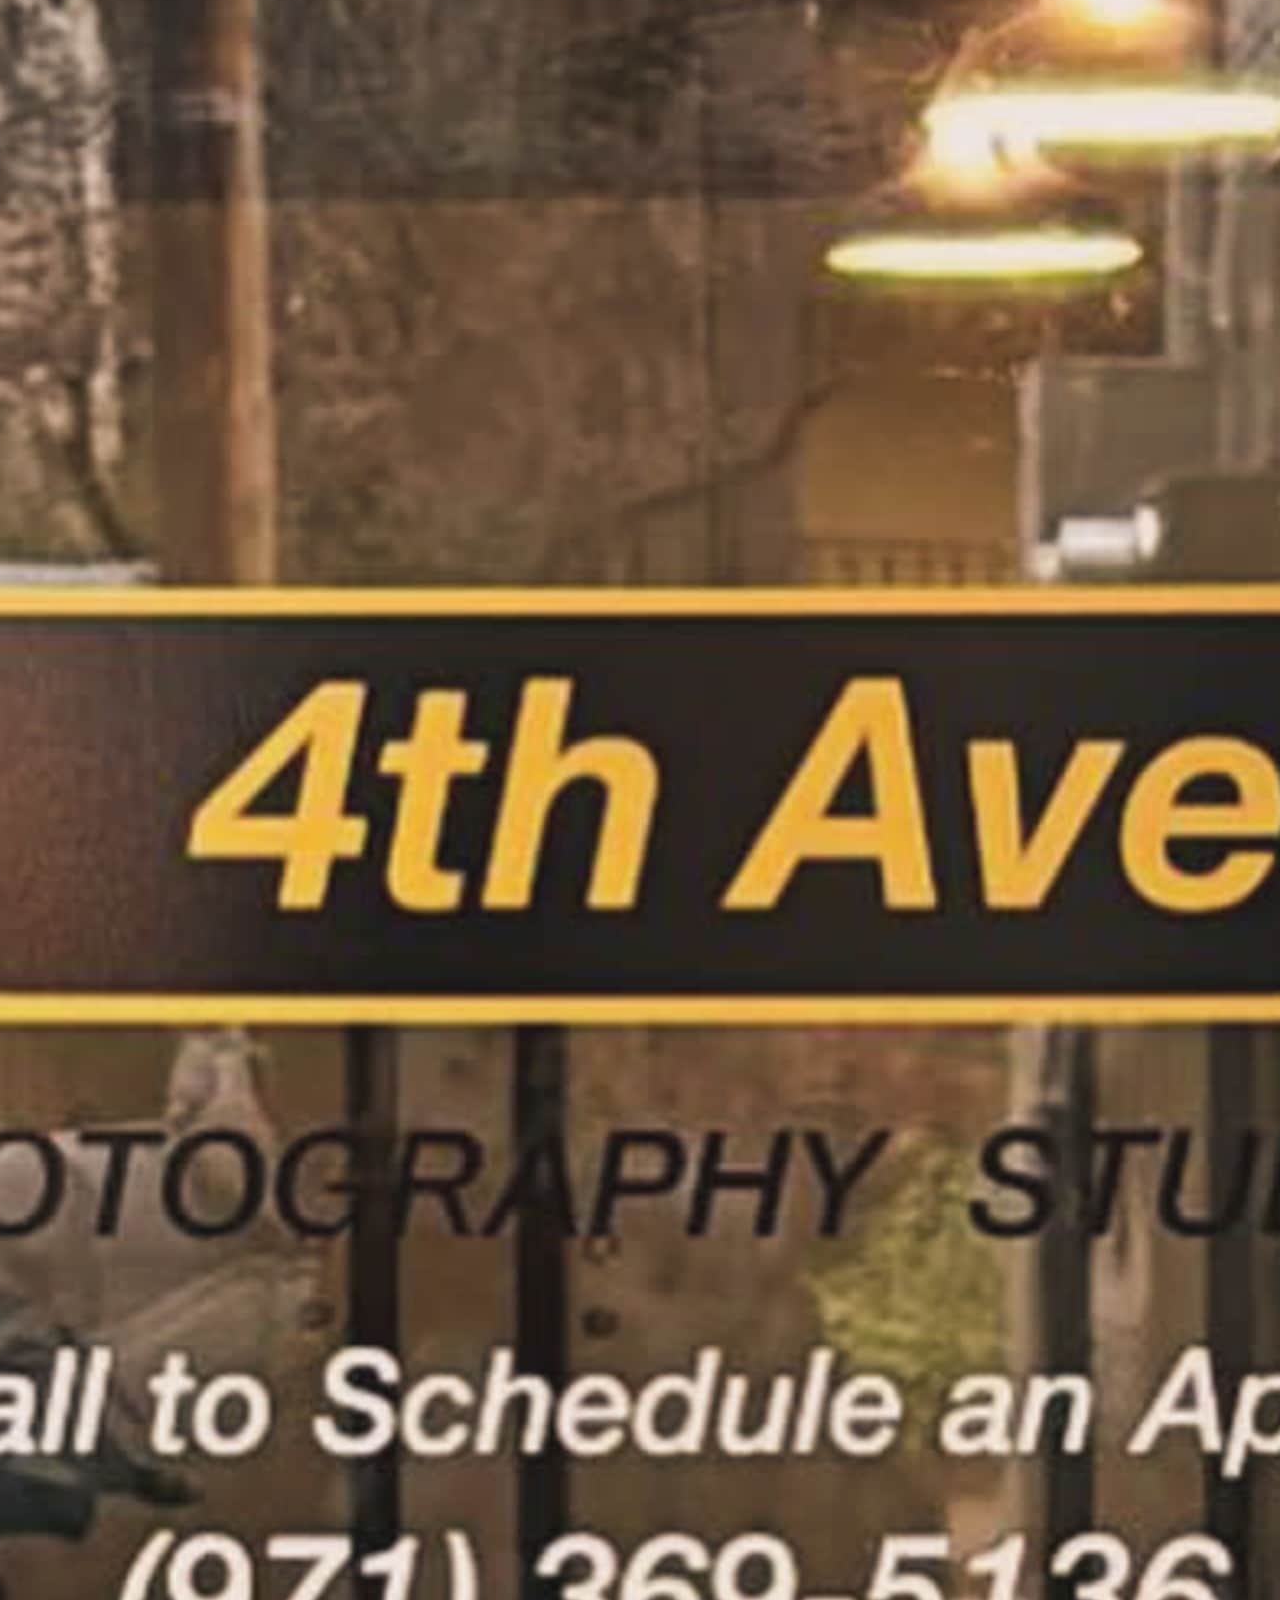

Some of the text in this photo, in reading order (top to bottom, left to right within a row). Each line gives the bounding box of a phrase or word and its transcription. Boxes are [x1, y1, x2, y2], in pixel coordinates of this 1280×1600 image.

[186, 676, 660, 912] 4th
[148, 1353, 272, 1455] to
[315, 1346, 904, 1455] Schedule
[940, 1372, 1093, 1455] an
